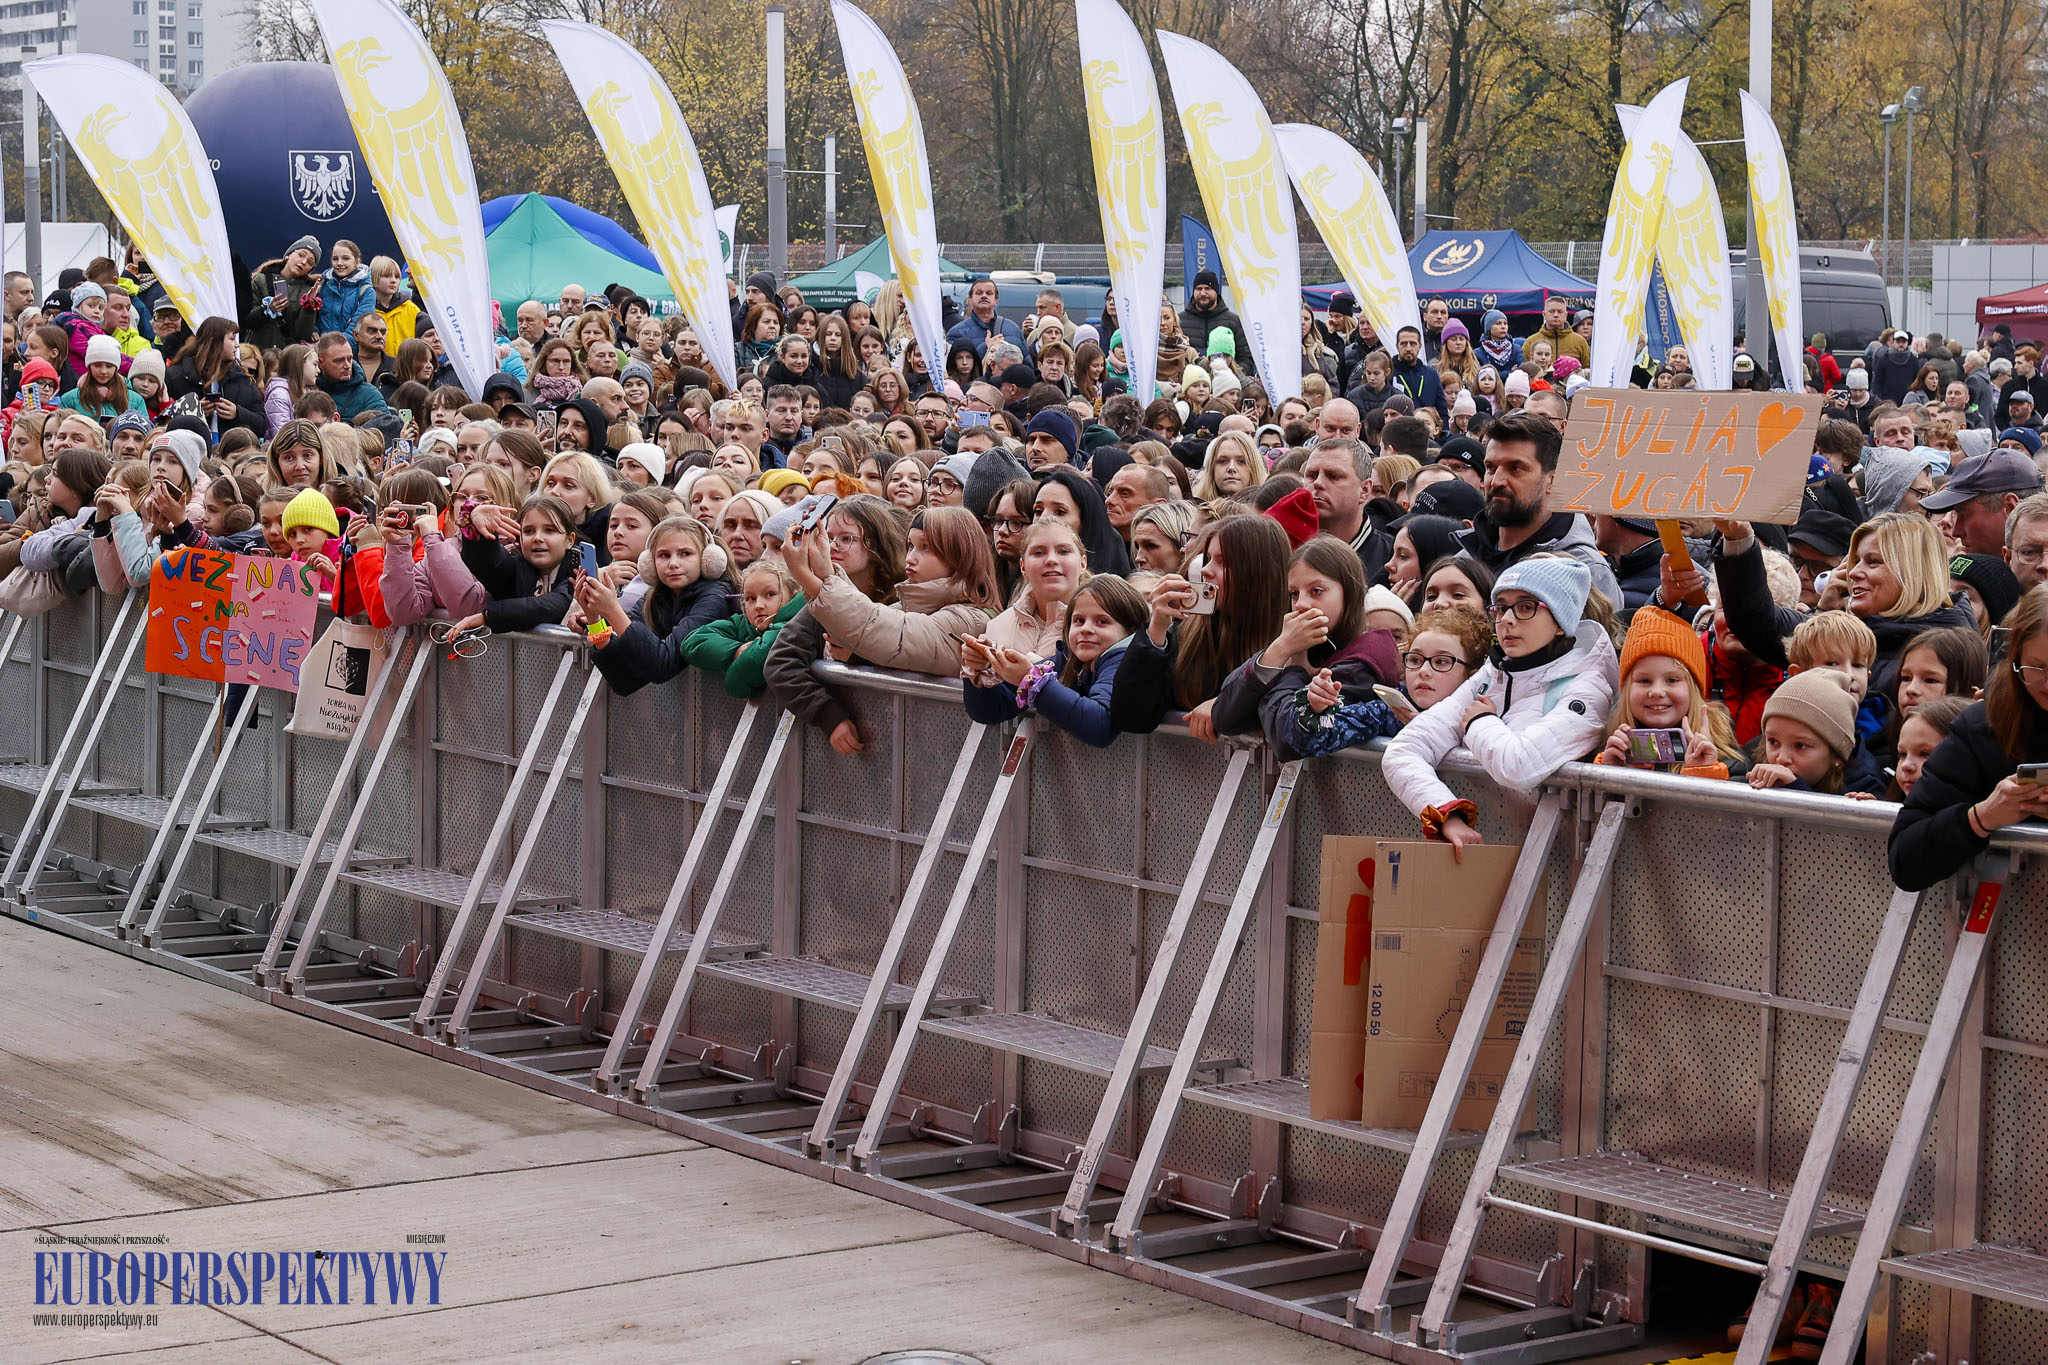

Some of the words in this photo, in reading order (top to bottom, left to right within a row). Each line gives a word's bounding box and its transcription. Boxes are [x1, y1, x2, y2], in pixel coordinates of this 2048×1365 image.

[1445, 298, 1477, 309] KOLEI
[1576, 395, 1740, 460] JULIA
[1563, 457, 1755, 516] ŻUGAJ
[160, 551, 233, 592] WEŹ
[245, 560, 318, 597] NAS
[214, 599, 249, 621] NA
[173, 615, 304, 687] SCENĘ
[327, 697, 347, 710] TORBA
[347, 704, 357, 712] NA
[1372, 983, 1383, 997] 12
[1371, 1001, 1382, 1016] 00
[1369, 1020, 1381, 1036] 59
